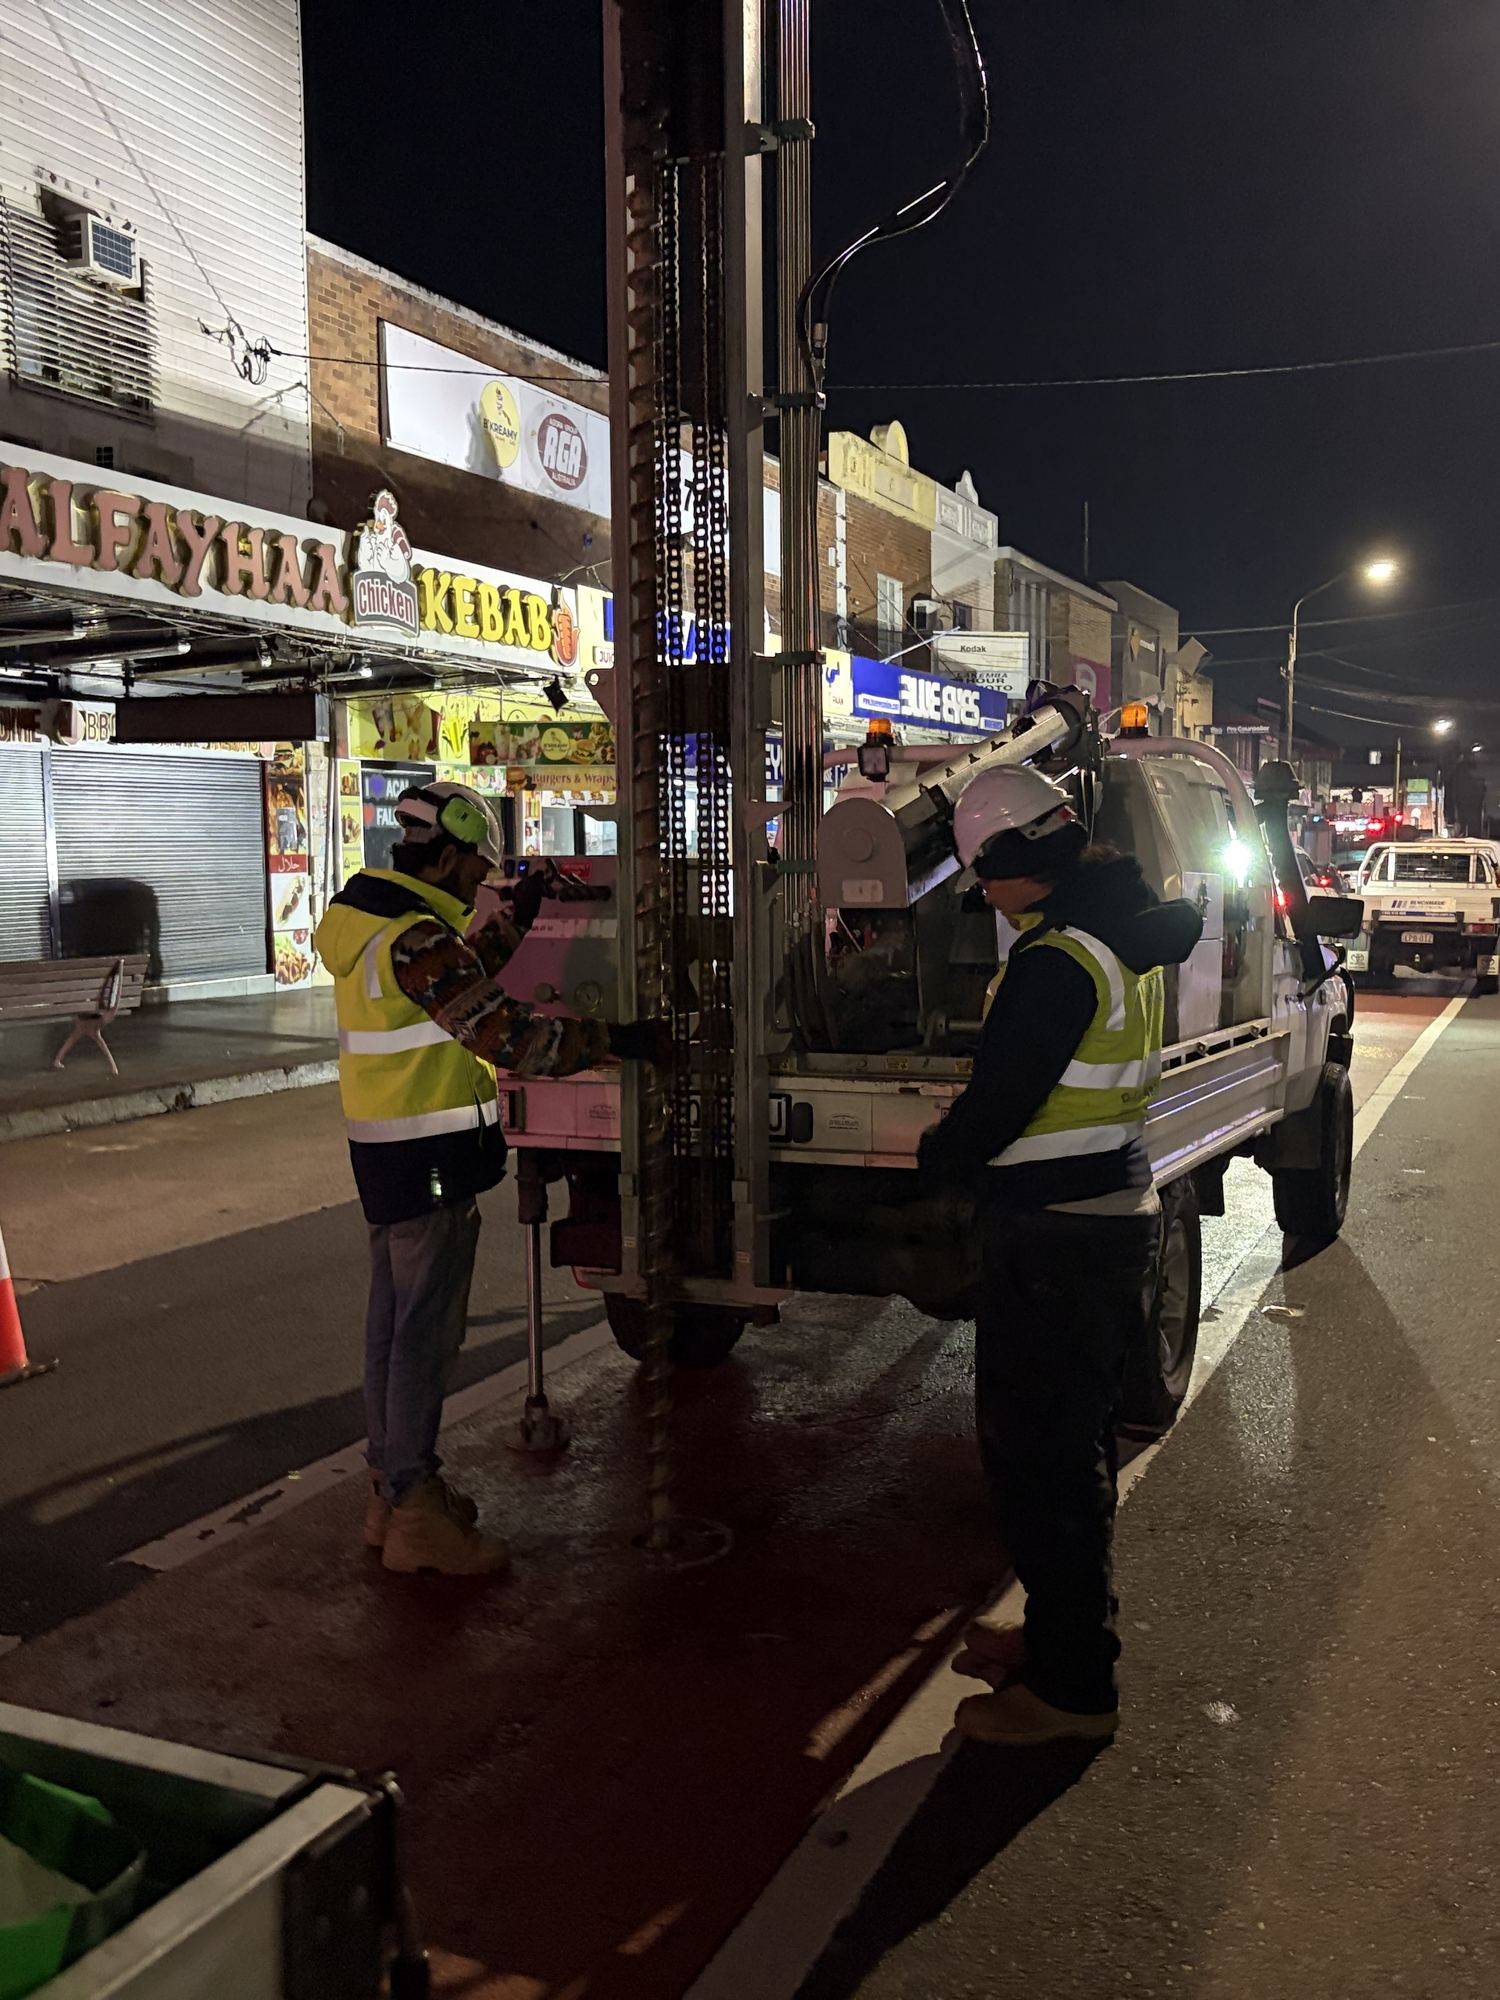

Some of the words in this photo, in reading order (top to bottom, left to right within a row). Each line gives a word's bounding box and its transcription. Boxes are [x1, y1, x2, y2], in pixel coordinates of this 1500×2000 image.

[0, 467, 349, 612] ALFAYHAA
[358, 579, 416, 628] Chicken
[421, 568, 552, 651] KEBAB
[960, 645, 987, 653] Kodak
[532, 773, 572, 786] Burgers
[574, 774, 581, 784] &
[584, 773, 615, 788] Wraps
[278, 856, 300, 873] حلال
